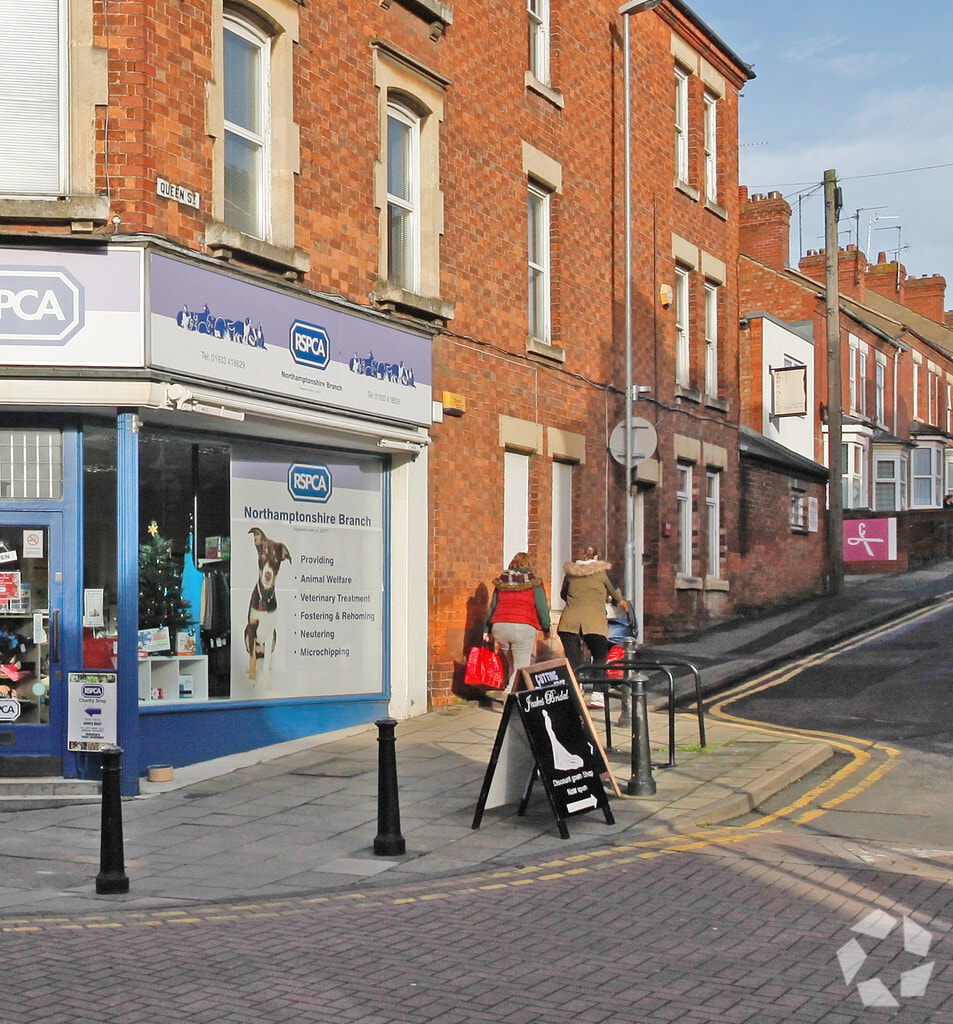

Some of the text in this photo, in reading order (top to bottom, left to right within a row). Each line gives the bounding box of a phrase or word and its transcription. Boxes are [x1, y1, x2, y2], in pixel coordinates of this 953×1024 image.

[160, 182, 185, 201] QUEEN
[295, 332, 326, 358] RSPCA
[211, 353, 226, 365] 01933
[280, 370, 326, 388] Northamptonshire
[326, 381, 343, 392] Branch
[293, 473, 327, 492] RSPCA
[244, 506, 372, 527] Northamptonshire Branch
[300, 555, 334, 566] Providing
[300, 575, 352, 584] Animal Welfare
[300, 593, 371, 604] Veterinary Treatment
[300, 611, 375, 622] Fostering & Rehoming
[300, 629, 335, 640] Neutering
[300, 648, 350, 658] Microchipping
[544, 689, 569, 706] Bridal
